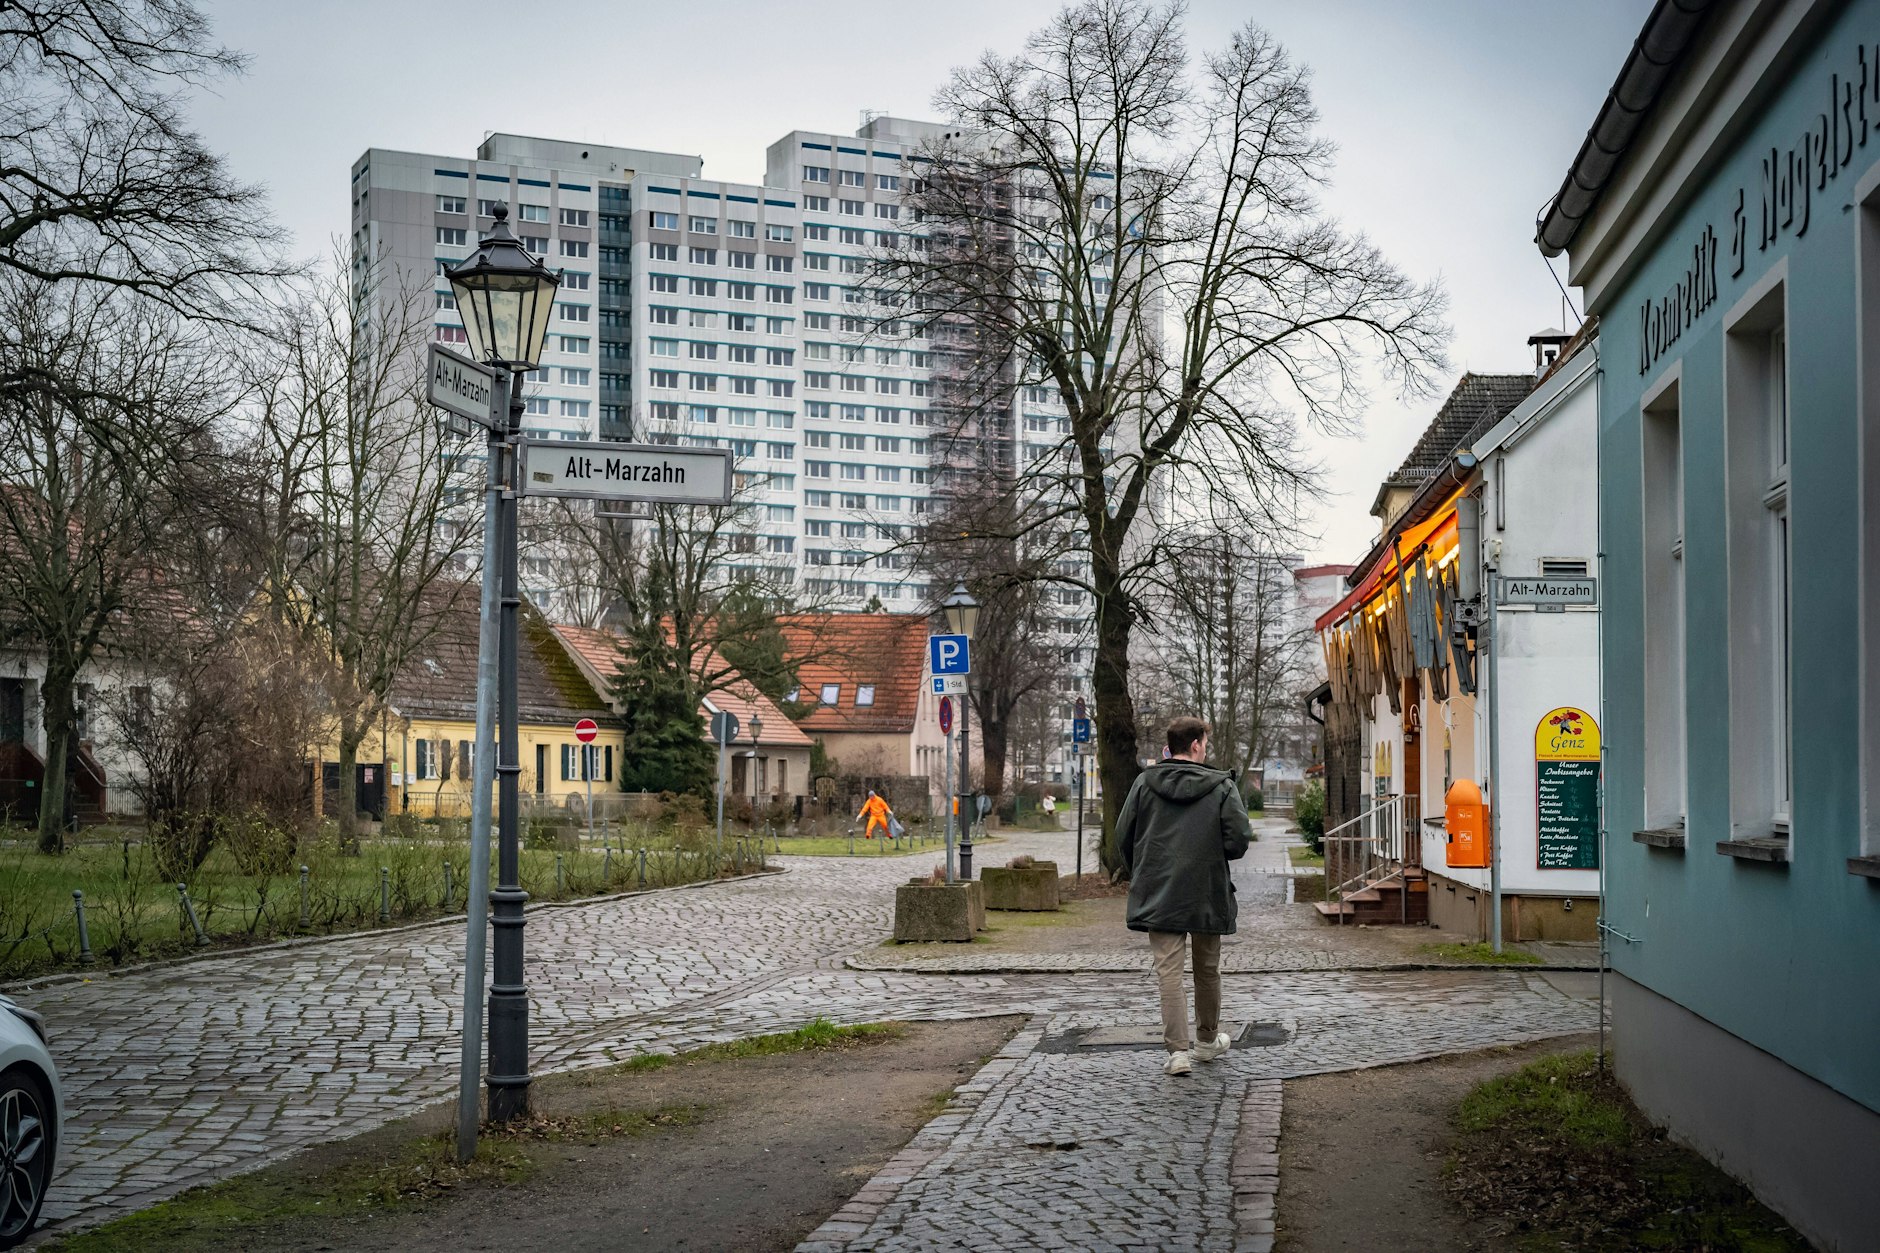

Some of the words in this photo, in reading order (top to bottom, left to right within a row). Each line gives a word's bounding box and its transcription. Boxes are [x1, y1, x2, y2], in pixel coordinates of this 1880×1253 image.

[1639, 224, 1718, 375] Kosmetik
[434, 359, 490, 407] Alt-Marzahn
[565, 456, 686, 484] Alt-Marzahn
[1510, 583, 1590, 596] Alt-Marzahn
[939, 640, 960, 670] P
[1551, 736, 1585, 752] Genz
[1545, 767, 1593, 777] Imbissangebot
